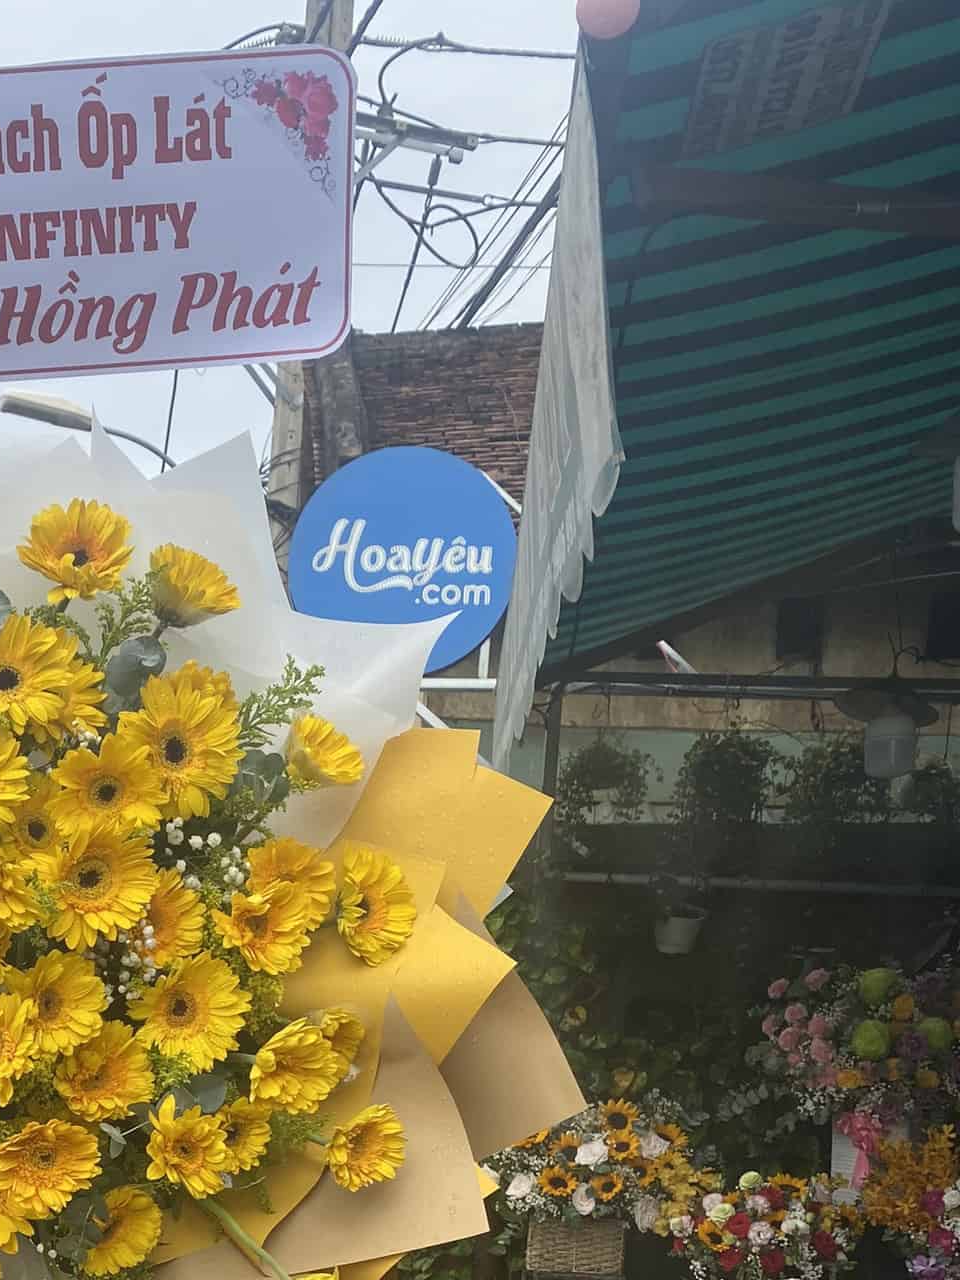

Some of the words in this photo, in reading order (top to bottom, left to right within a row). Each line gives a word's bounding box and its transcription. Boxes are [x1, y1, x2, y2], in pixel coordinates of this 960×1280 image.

[77, 72, 138, 180] Ốp
[153, 94, 233, 164] Lát
[172, 262, 321, 334] Phát
[415, 584, 491, 606] .com
